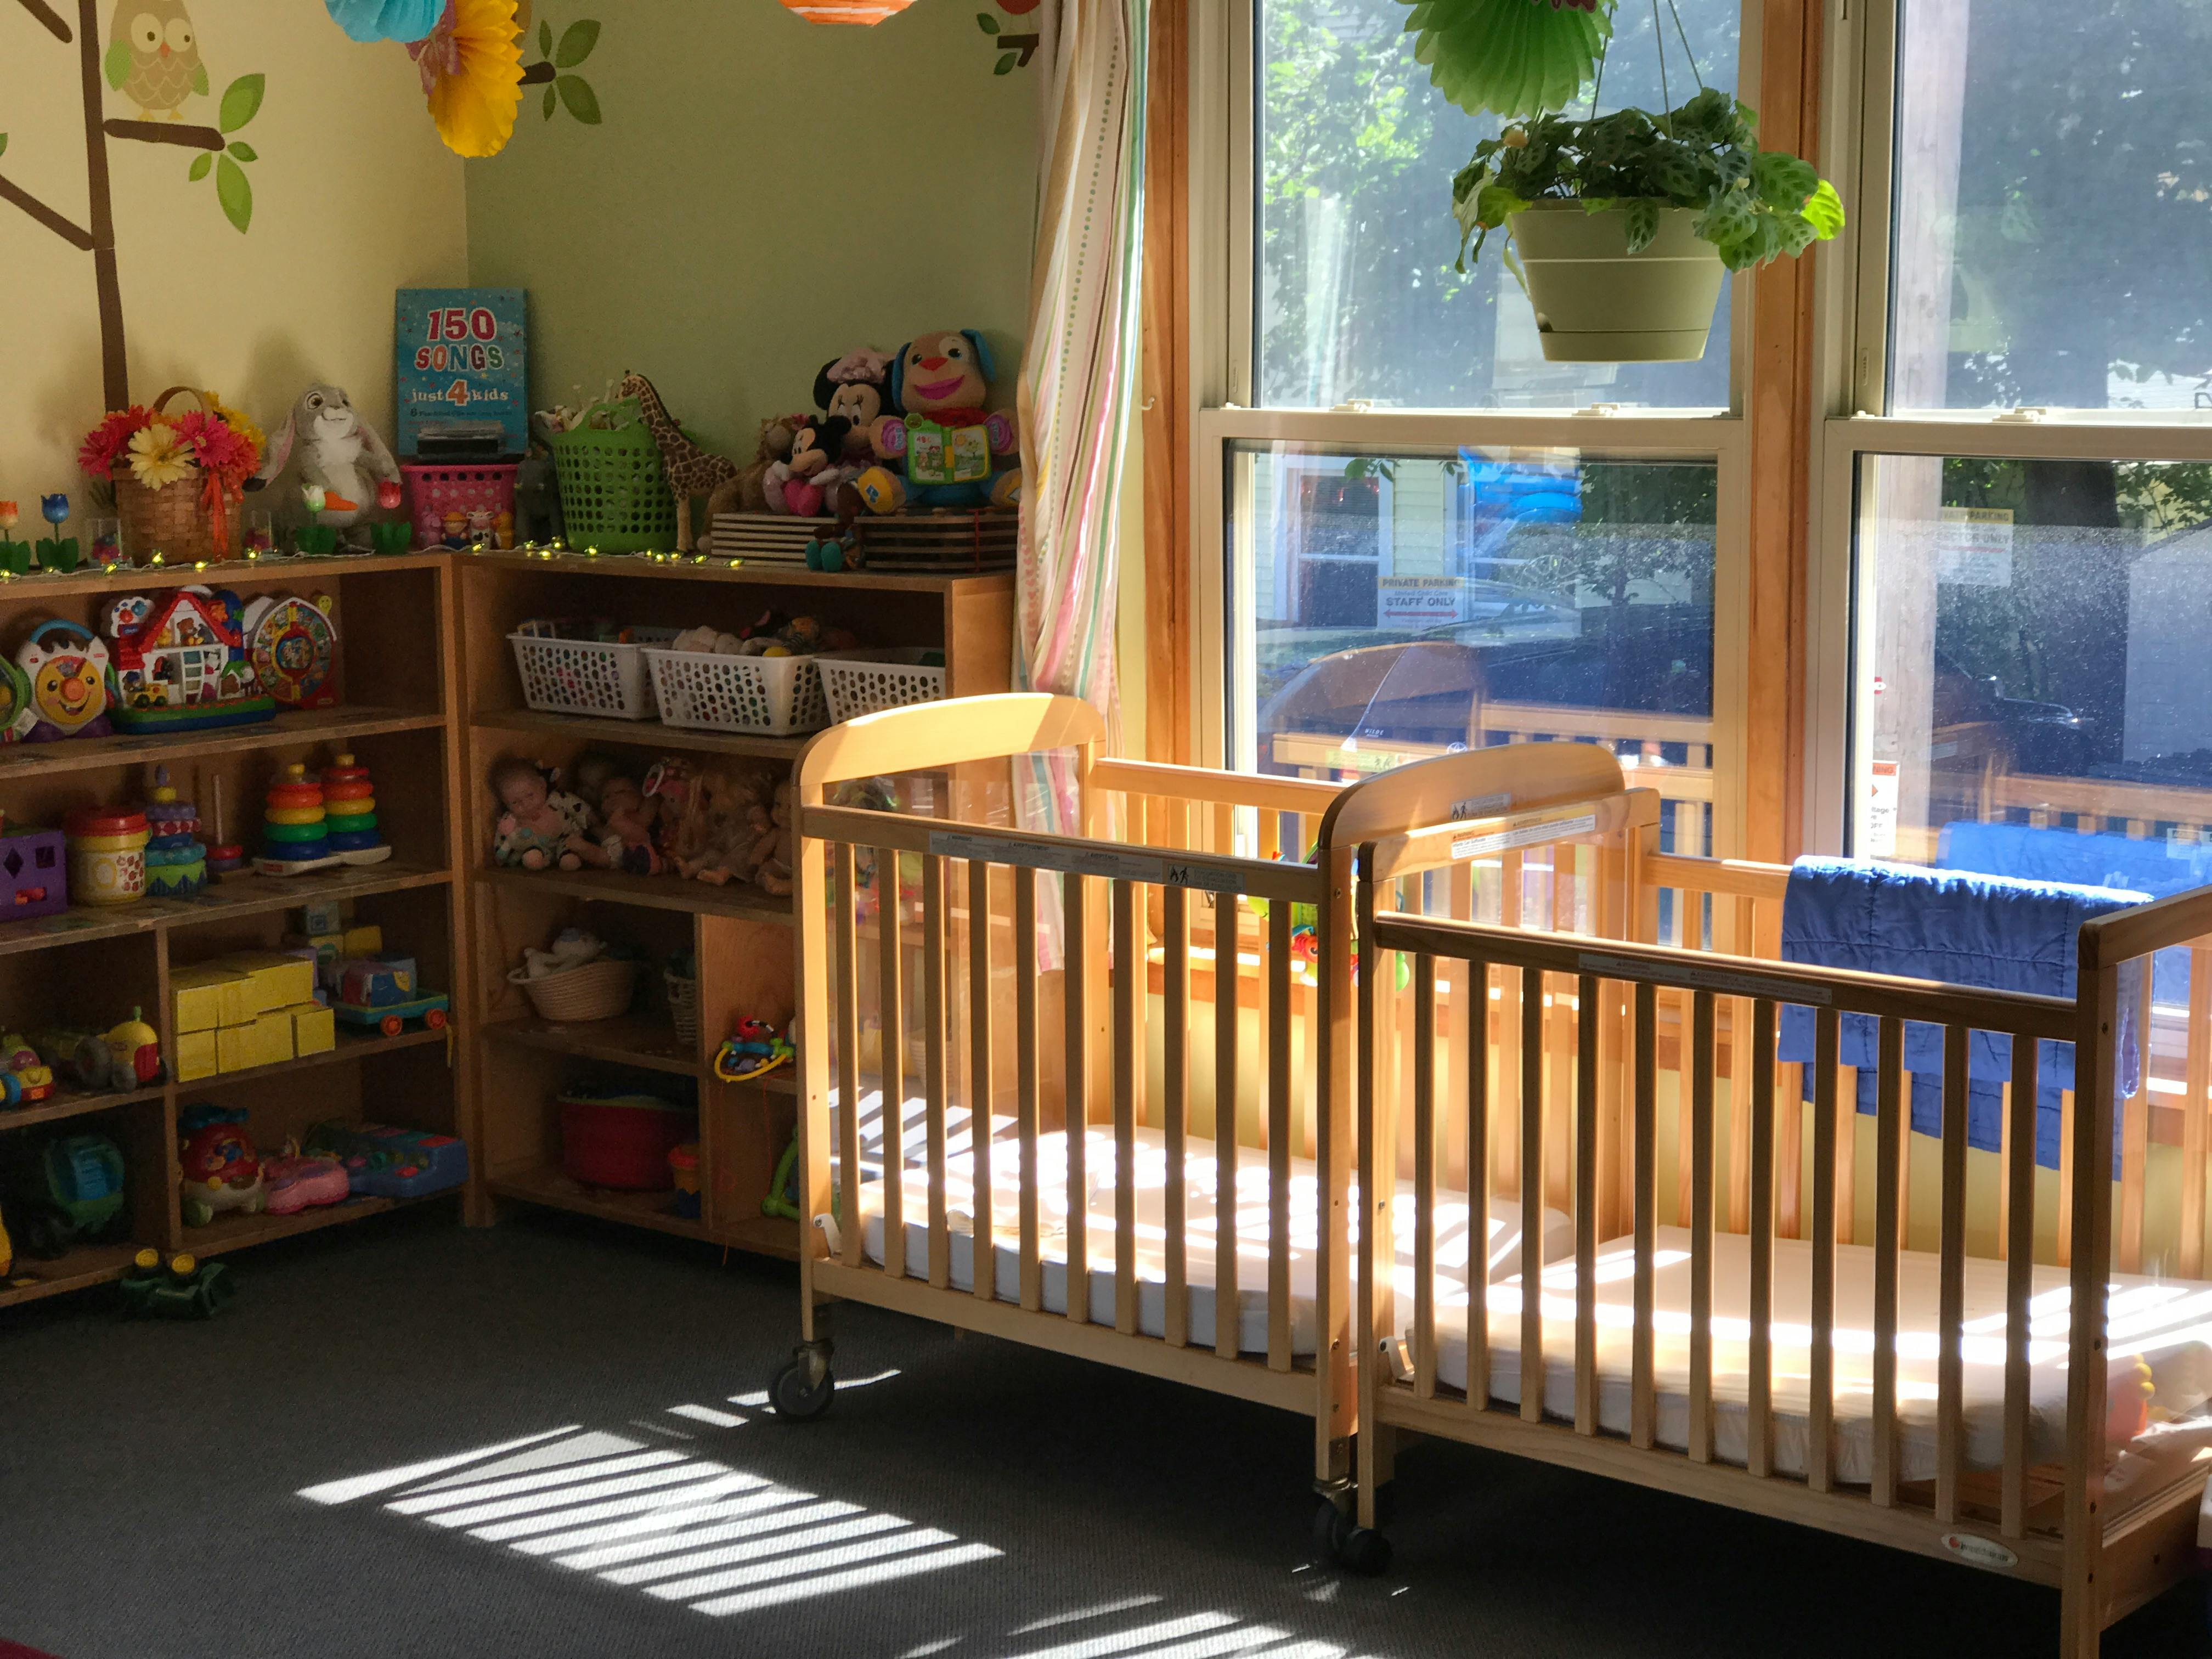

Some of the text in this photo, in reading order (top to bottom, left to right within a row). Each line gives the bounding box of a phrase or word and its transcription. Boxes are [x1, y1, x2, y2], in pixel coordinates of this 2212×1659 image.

[427, 307, 496, 342] 150
[415, 344, 504, 371] SONGS
[411, 379, 509, 407] just 4 kids
[1970, 510, 2010, 521] PARKING
[1983, 533, 2010, 544] ONLY
[1383, 578, 1419, 588] PRIVATE
[1386, 597, 1455, 606] STAFF ONLY
